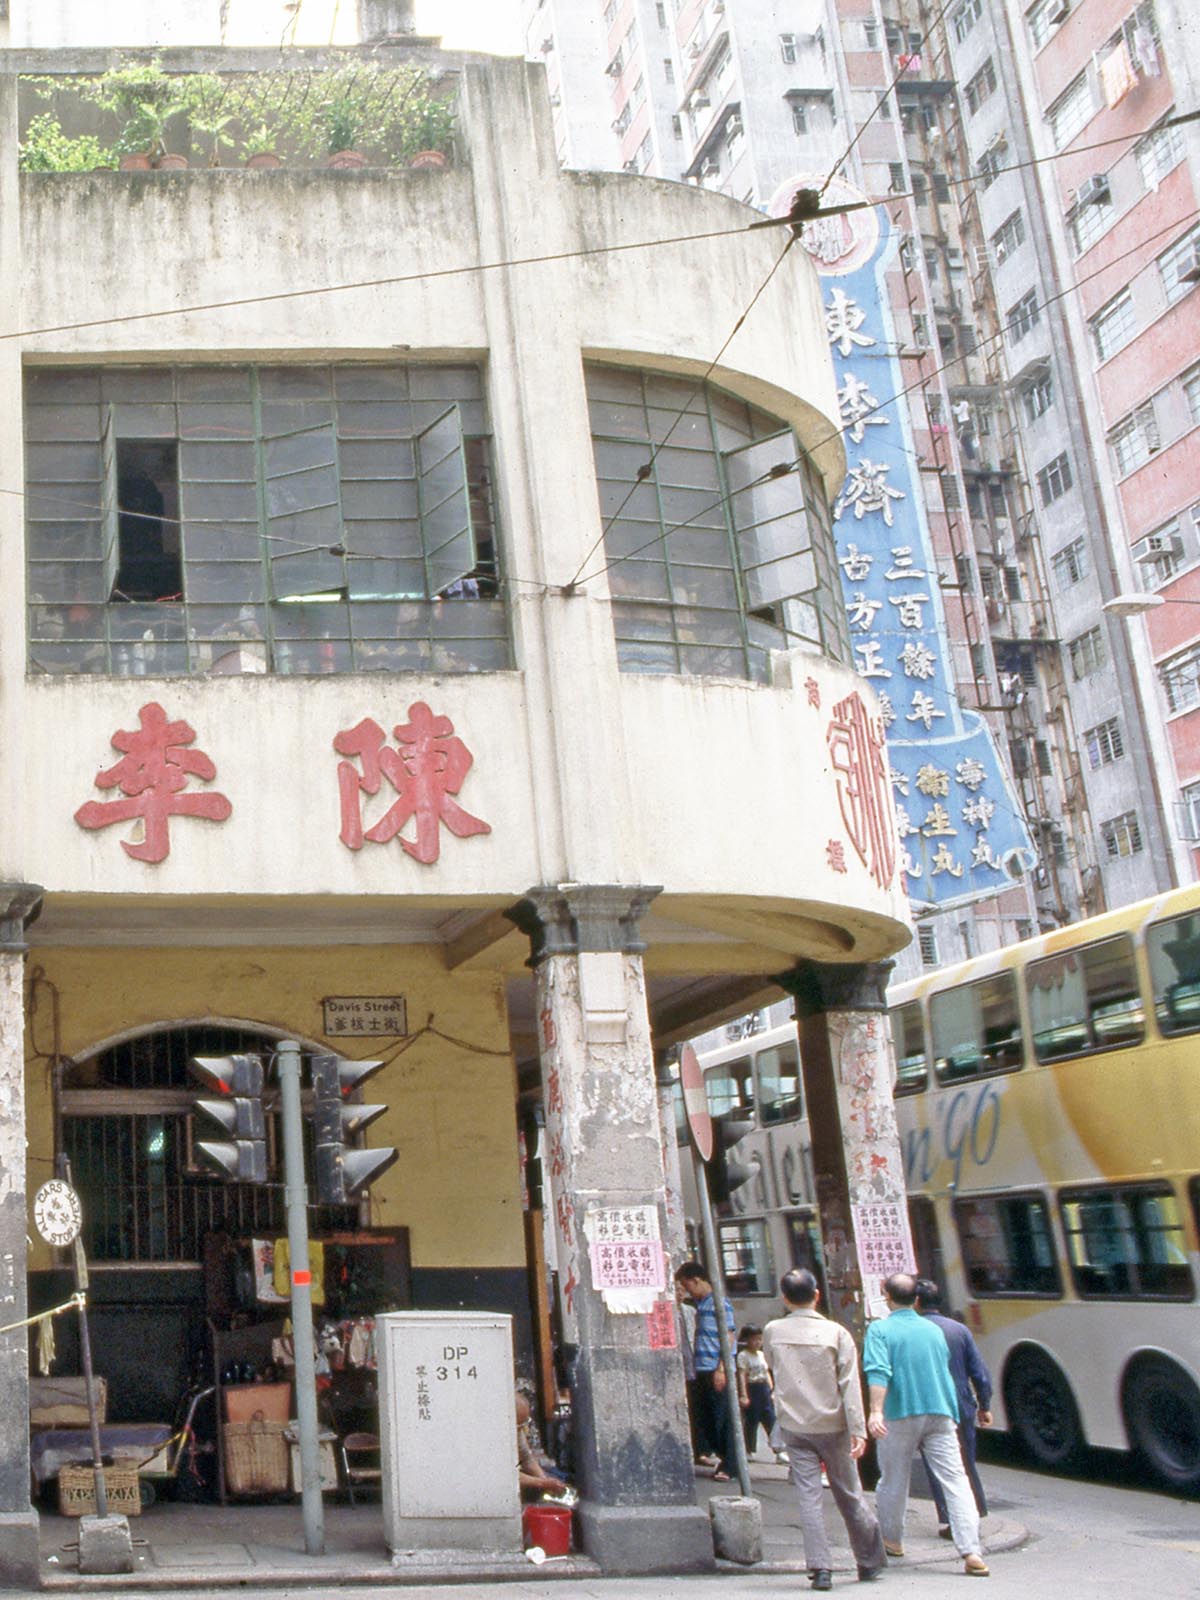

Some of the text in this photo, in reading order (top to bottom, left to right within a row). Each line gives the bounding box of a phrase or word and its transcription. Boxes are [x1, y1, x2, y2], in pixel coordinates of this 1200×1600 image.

[884, 545, 946, 732] 三百餘年
[915, 763, 964, 878] 衛生丸
[329, 1001, 401, 1013] Davis Street
[37, 1183, 63, 1204] CARS
[35, 1208, 48, 1233] ALL
[50, 1226, 74, 1244] STOP
[65, 1191, 81, 1225] HERE
[443, 1346, 469, 1360] DP
[436, 1365, 478, 1381] 314
